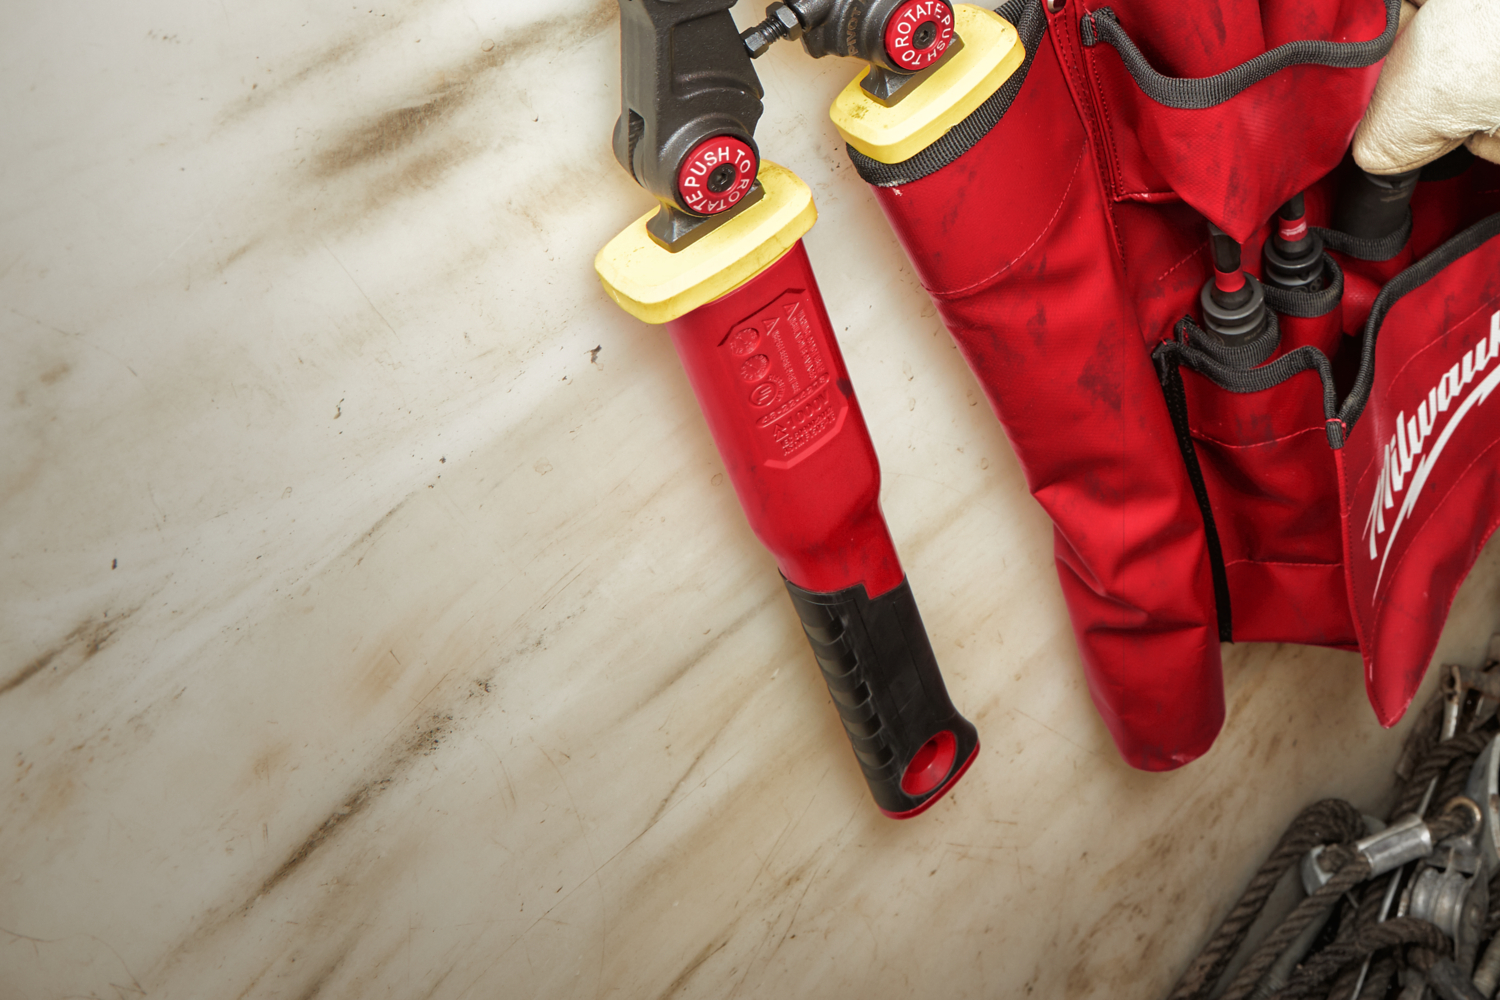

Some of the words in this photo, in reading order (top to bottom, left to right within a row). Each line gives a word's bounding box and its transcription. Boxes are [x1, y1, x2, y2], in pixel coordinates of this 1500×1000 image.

[846, 6, 862, 56] PIVOT
[894, 1, 945, 49] ROTATE
[927, 14, 952, 62] PUSH
[901, 49, 922, 66] TO
[684, 146, 730, 188] PUSH
[734, 149, 751, 174] TO
[685, 178, 750, 212] ROTATE
